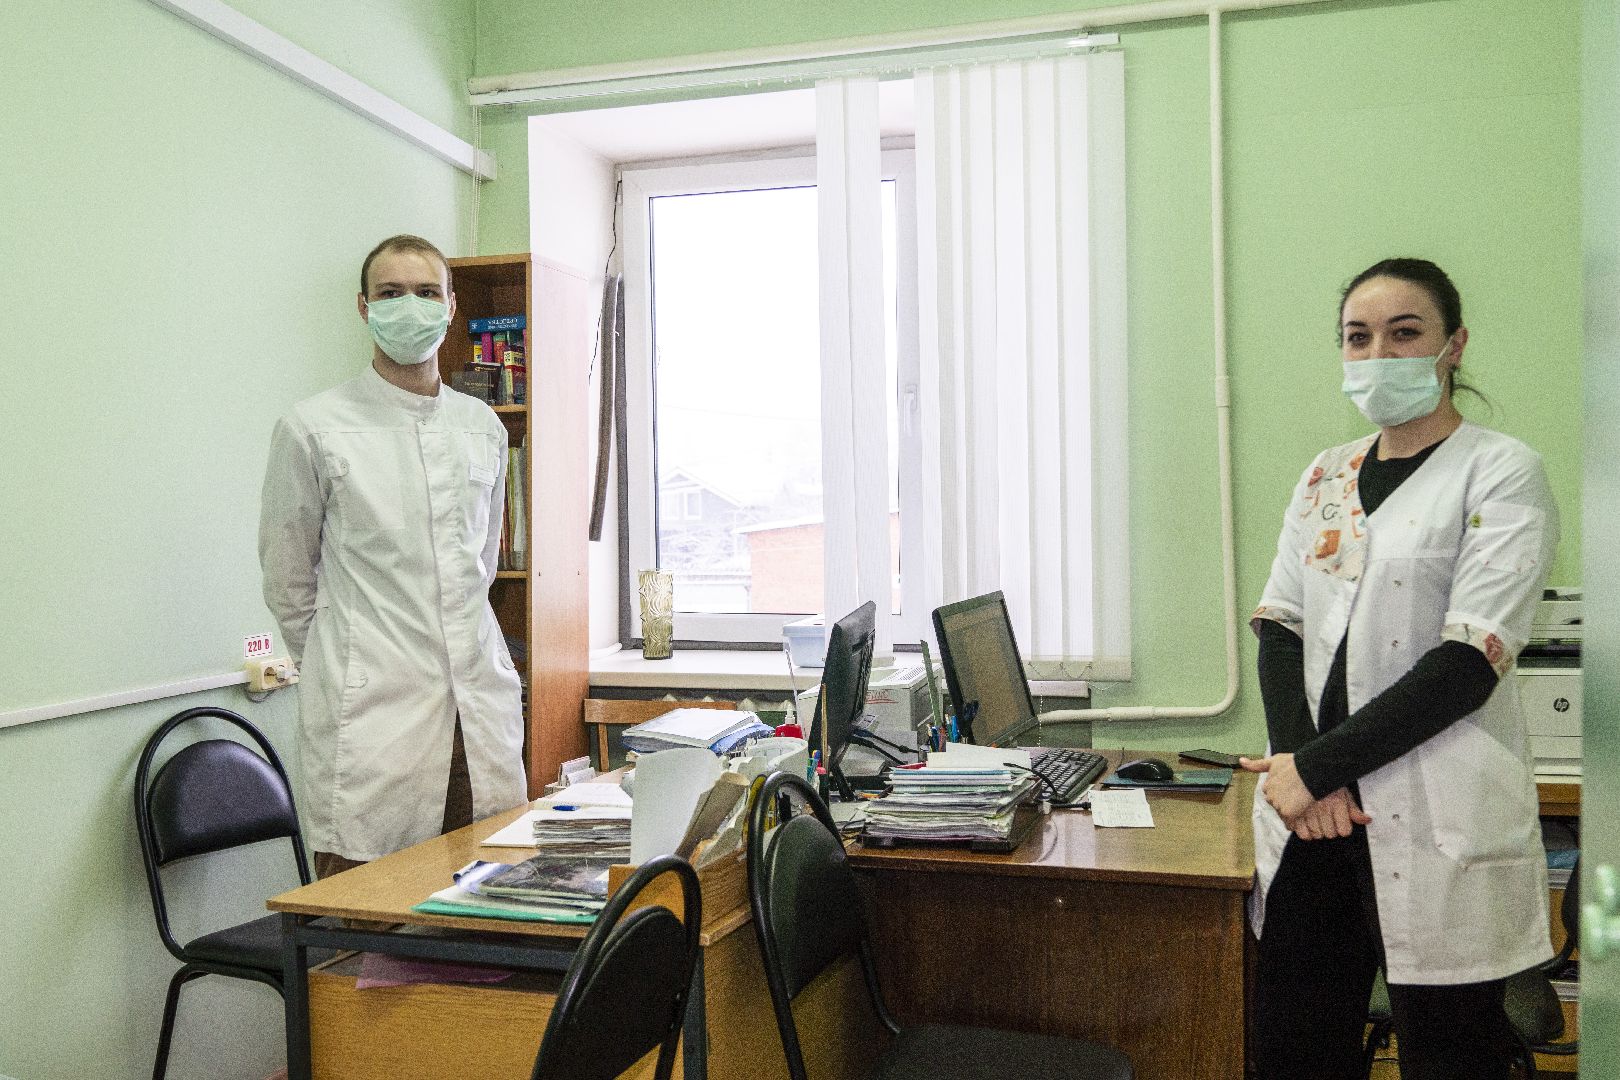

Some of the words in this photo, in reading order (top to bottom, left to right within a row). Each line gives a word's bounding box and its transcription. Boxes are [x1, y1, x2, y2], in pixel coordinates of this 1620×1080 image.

[248, 639, 262, 652] 220
[264, 638, 270, 649] В
[1555, 698, 1568, 712] hp
